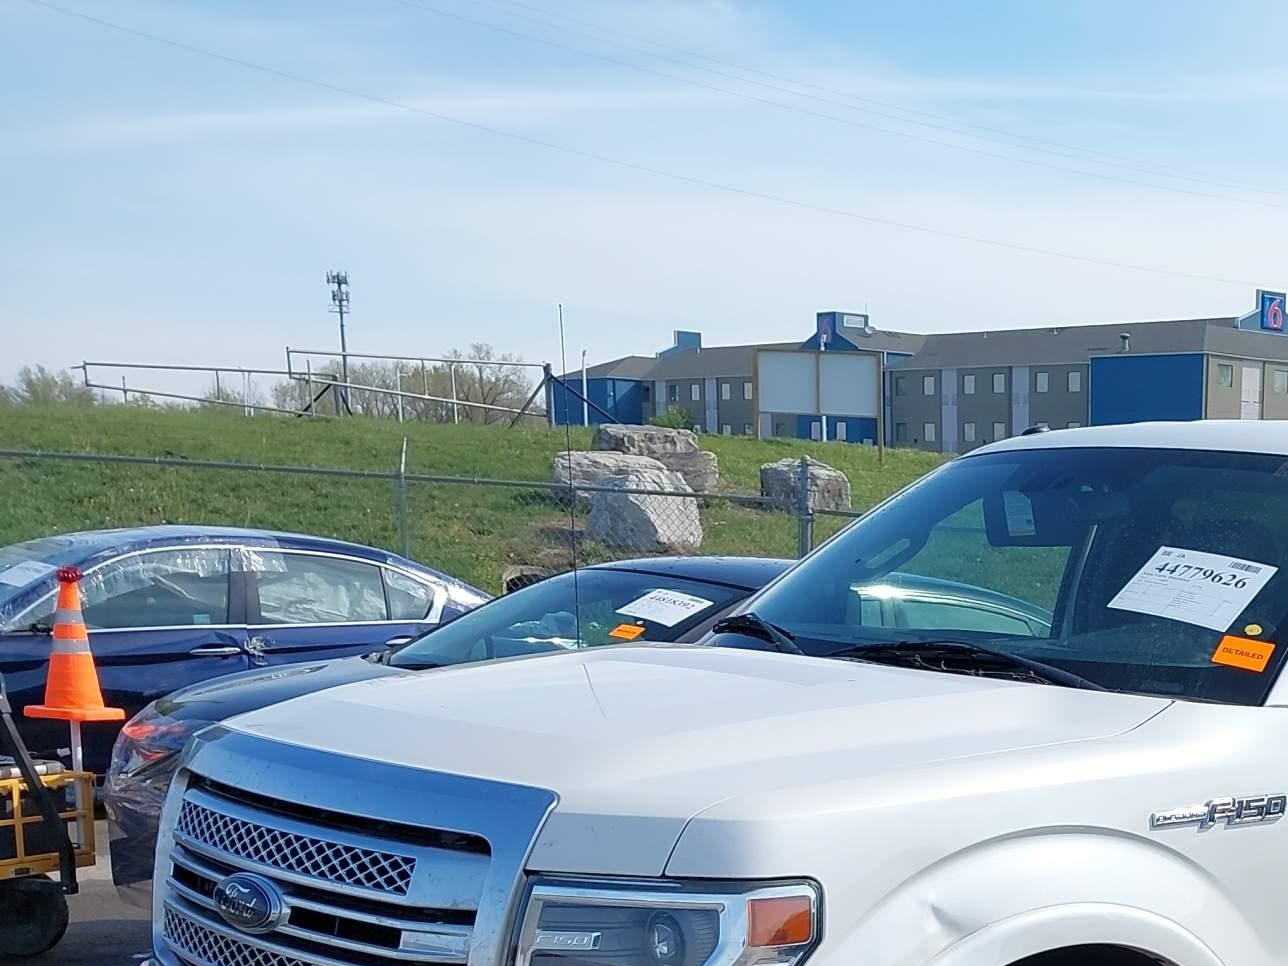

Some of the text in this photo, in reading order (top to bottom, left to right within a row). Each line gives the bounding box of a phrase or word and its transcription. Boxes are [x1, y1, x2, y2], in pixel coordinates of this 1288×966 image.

[1267, 298, 1282, 329] 6
[1155, 562, 1248, 589] 44779626
[1222, 647, 1264, 660] DETAILED
